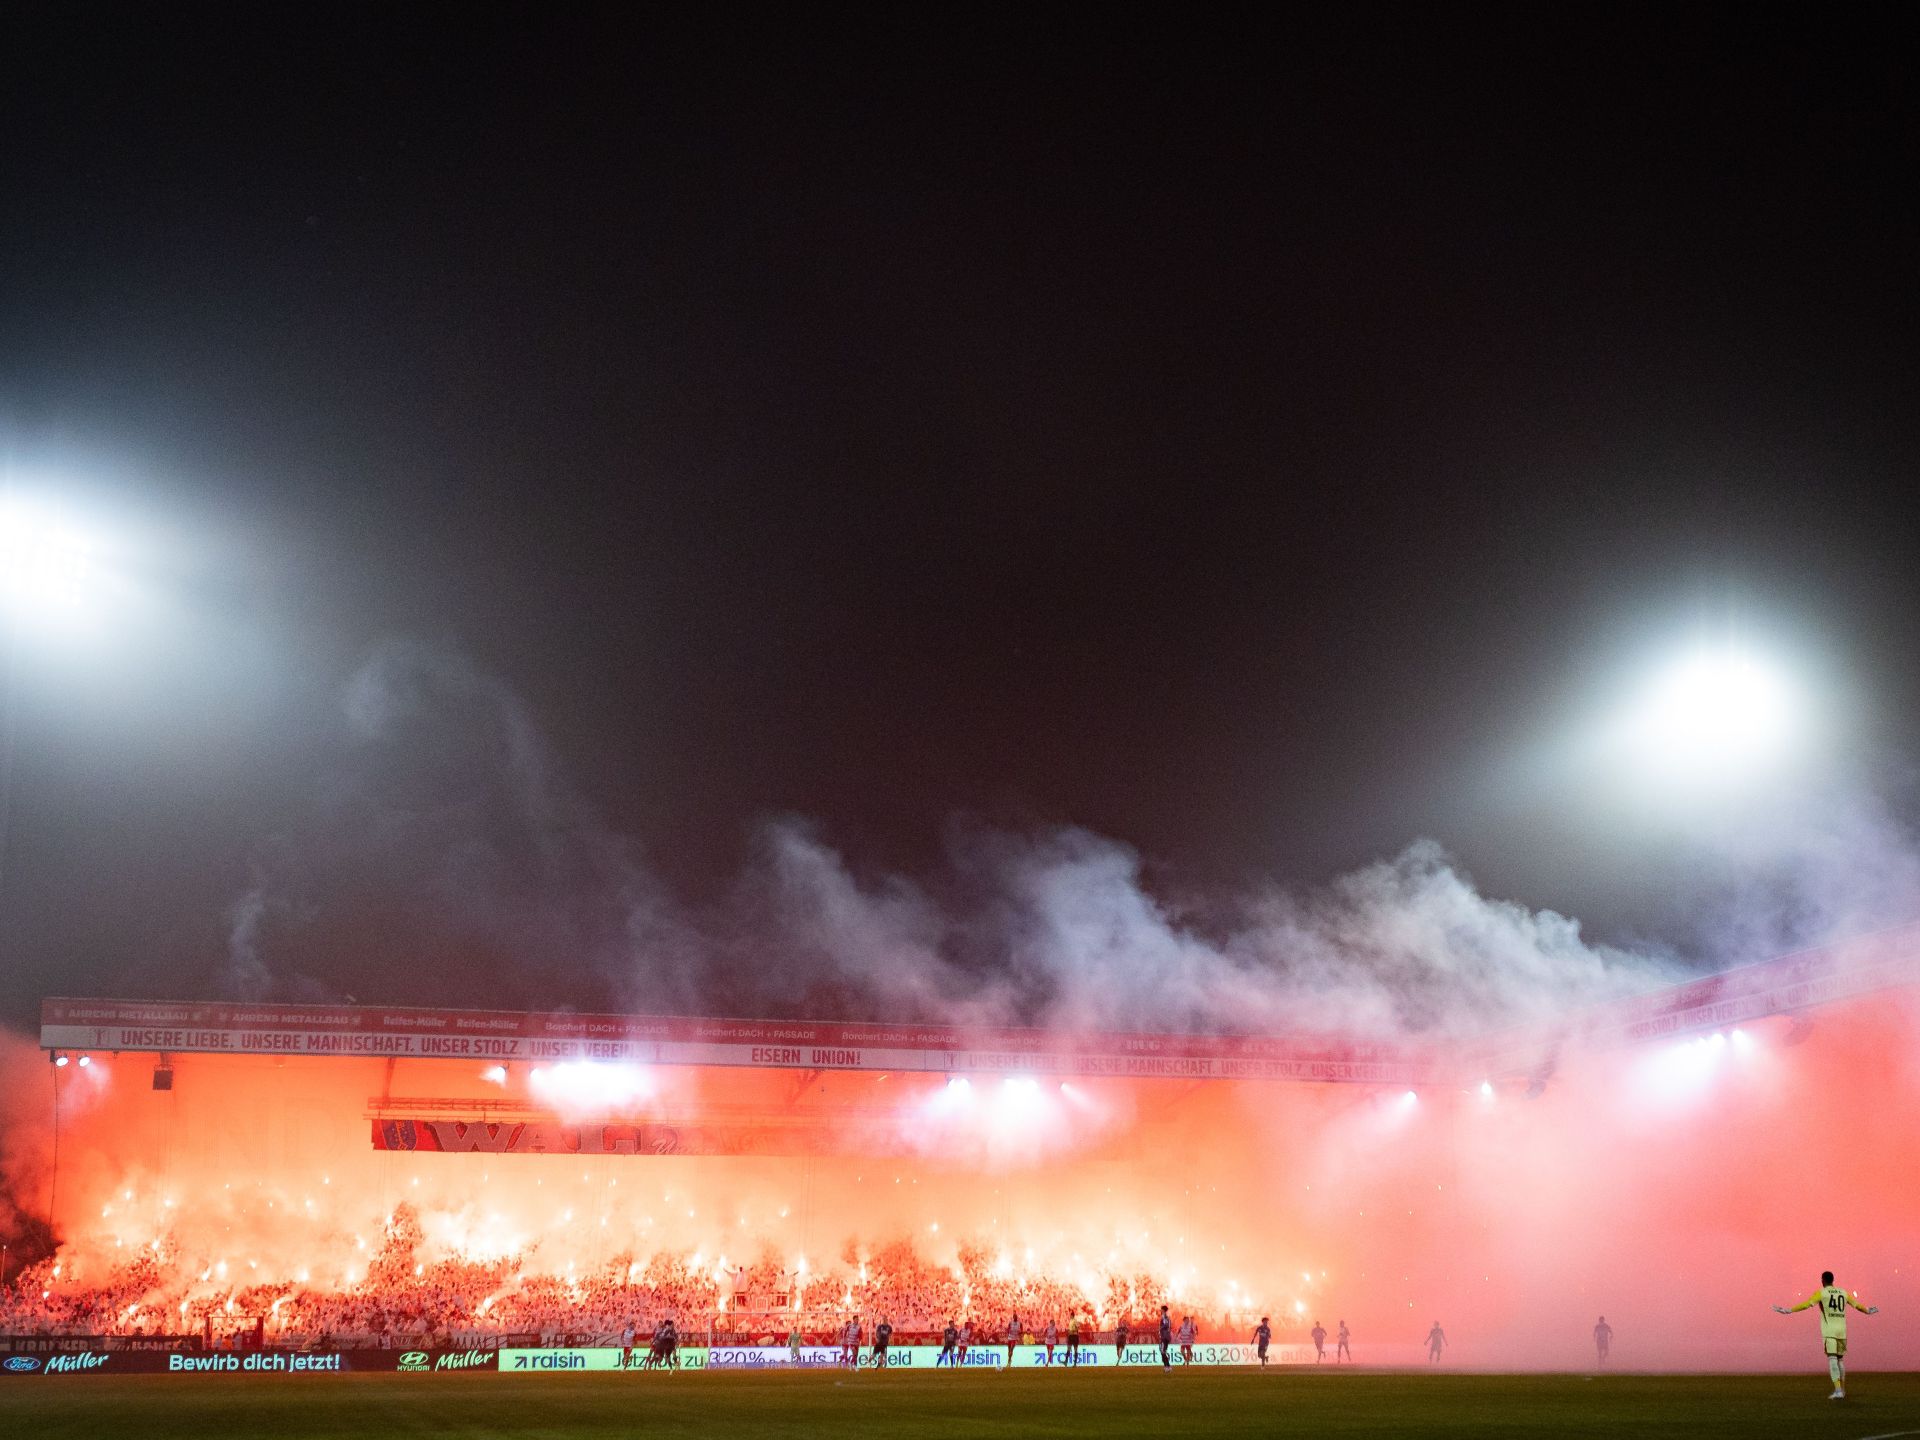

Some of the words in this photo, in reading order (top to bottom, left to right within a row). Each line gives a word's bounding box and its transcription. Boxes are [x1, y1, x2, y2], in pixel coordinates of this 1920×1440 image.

[589, 1023, 615, 1033] DACH
[738, 1030, 763, 1038] DACH
[773, 1030, 815, 1039] FASSADE
[120, 1030, 182, 1047] UNSERE
[186, 1031, 235, 1049] LIEBE.
[241, 1033, 301, 1050] UNSERE
[306, 1034, 415, 1052] MANNSCHAFT.
[421, 1037, 469, 1054] UNSER
[473, 1039, 522, 1055] STOLZ.
[530, 1041, 578, 1057] UNSER
[883, 1033, 907, 1042] DACH
[751, 1047, 801, 1063] EISERN
[812, 1049, 861, 1065] UNION!
[1312, 1063, 1352, 1078] UNSER
[1829, 1294, 1844, 1312] 40
[44, 1351, 109, 1375] Müller
[169, 1354, 239, 1371] Bewirb
[243, 1353, 285, 1370] dich
[288, 1353, 341, 1372] jetzt!
[435, 1351, 494, 1372] Müller
[532, 1352, 586, 1368] raisin
[684, 1355, 704, 1367] zu
[1122, 1349, 1158, 1364] Jetzt
